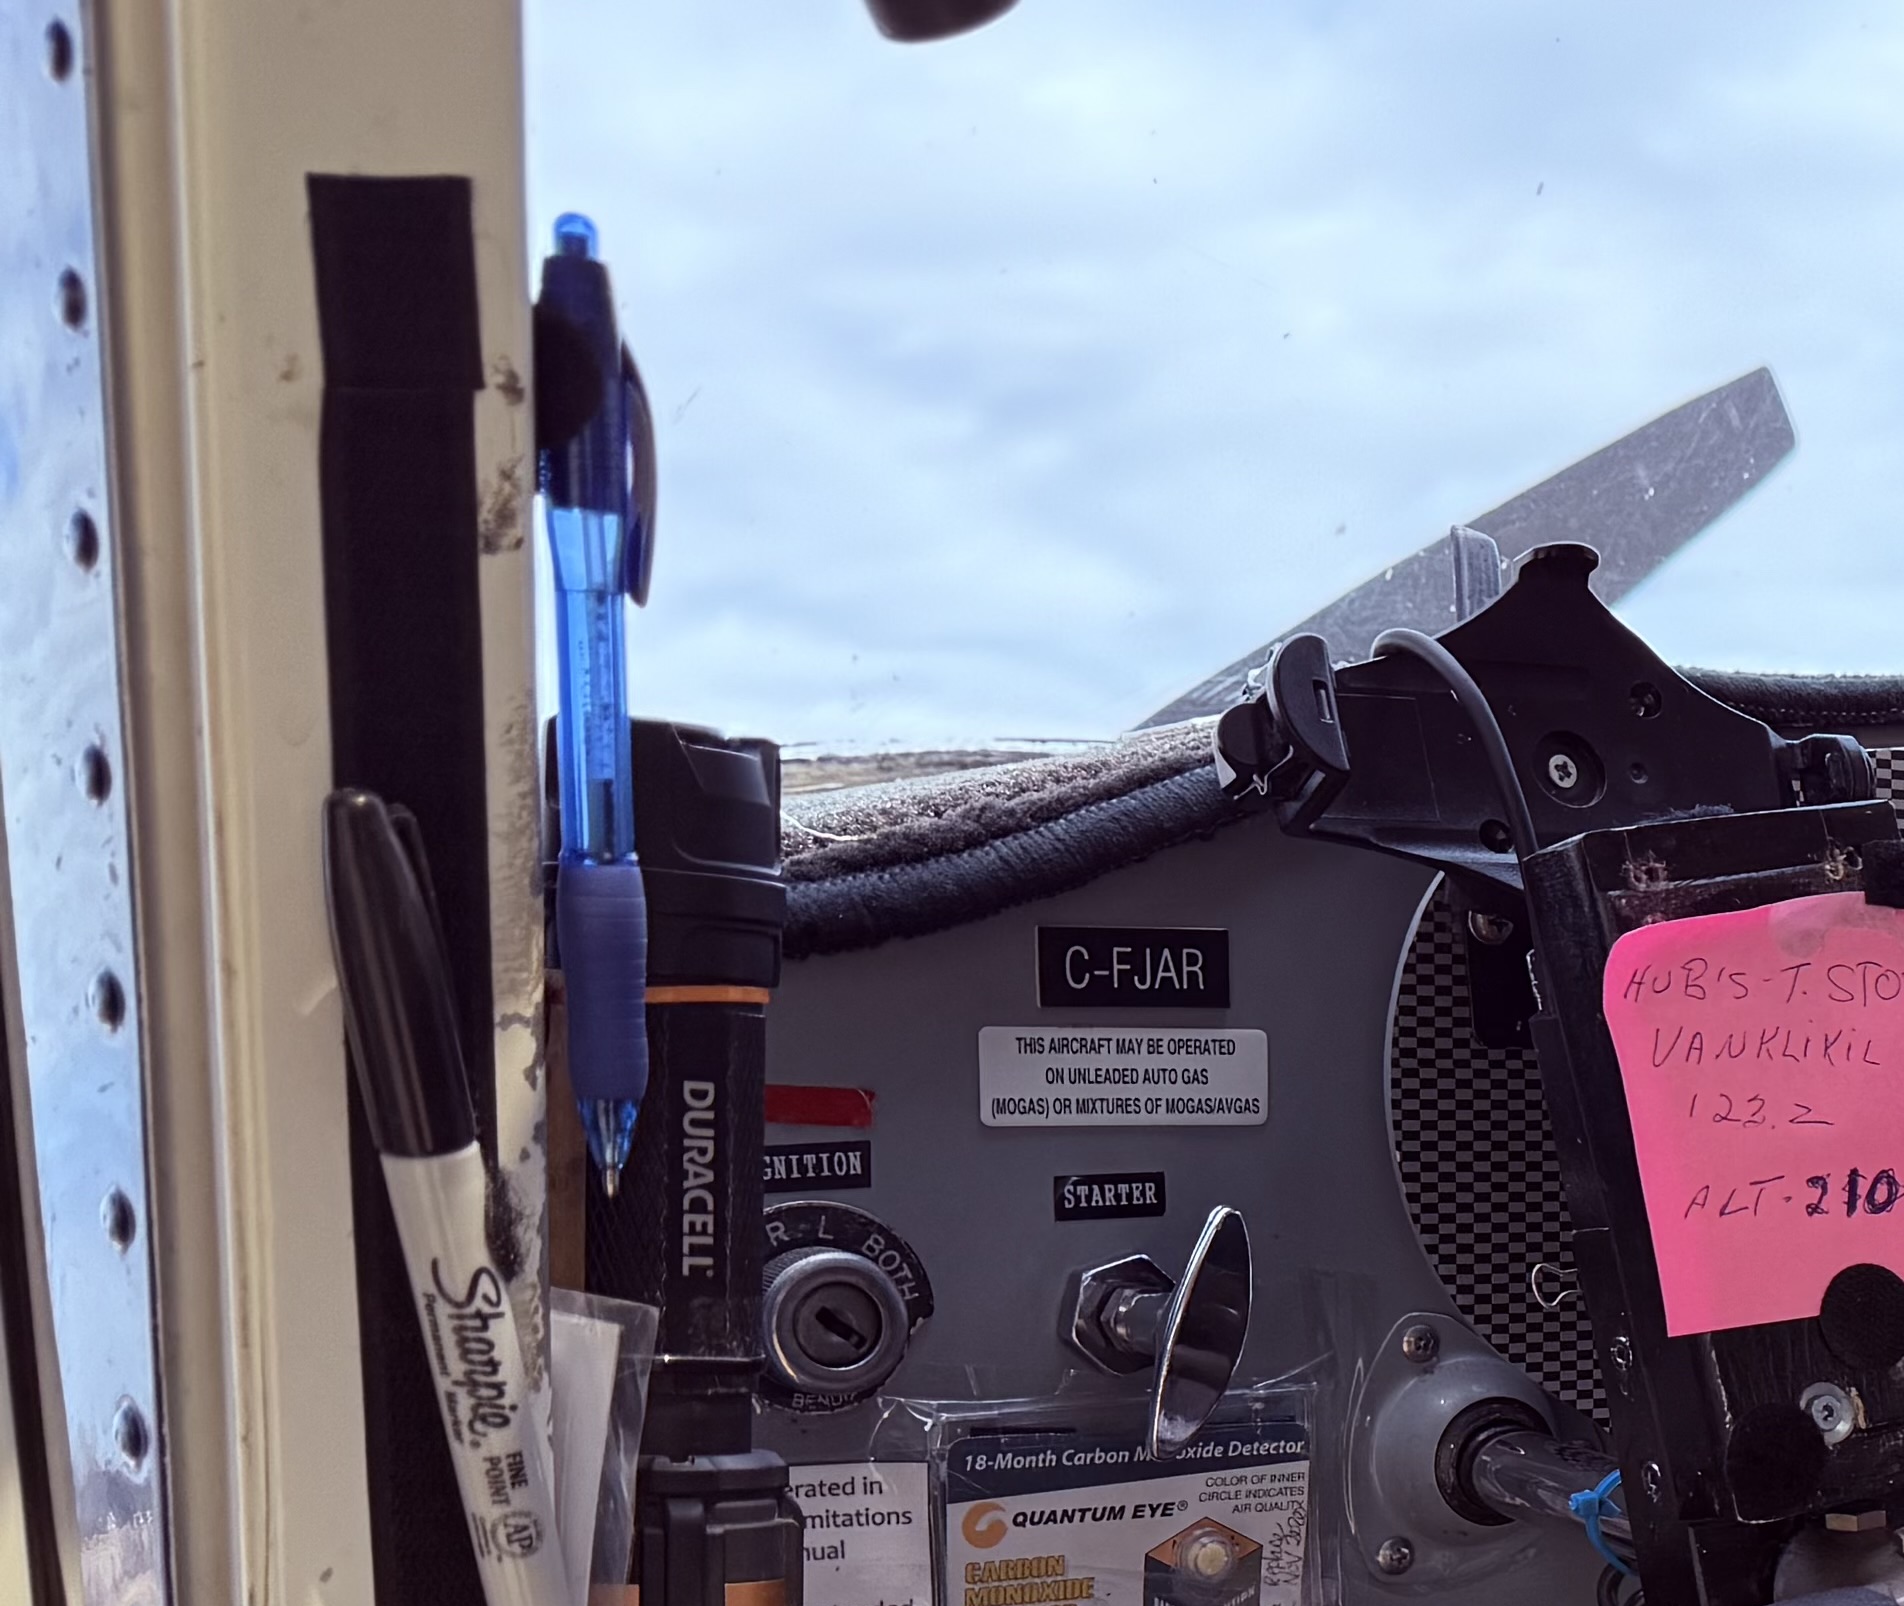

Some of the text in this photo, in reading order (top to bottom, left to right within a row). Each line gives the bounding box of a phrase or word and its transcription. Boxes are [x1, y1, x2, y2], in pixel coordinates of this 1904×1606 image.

[1065, 945, 1205, 990] C-FJAR
[1016, 1037, 1236, 1056] THIS AIRCRAFT MAY BE OPERATED
[1045, 1067, 1209, 1085] ON UNLEADED AUTO GAS
[991, 1097, 1260, 1119] (MOGAS) OR MIXTURES OF MOGAS/AVGAS
[763, 1151, 863, 1180] GNITION
[682, 1080, 715, 1277] DURACELL
[1063, 1182, 1158, 1208] STARTER
[861, 1233, 919, 1301] BOTH
[431, 1257, 519, 1439] Sharpie
[964, 1439, 1305, 1472] 18-Month Carbon Moxide Detector
[483, 1456, 511, 1507] POINT
[506, 1451, 529, 1490] FINE
[1205, 1471, 1305, 1487] COLOR OF INNER
[784, 1476, 883, 1498] erated in
[1199, 1486, 1305, 1503] CIRCLE INDICATES
[804, 1508, 913, 1529] mitations
[1012, 1504, 1125, 1528] QUANTUM
[1232, 1499, 1305, 1514] AIR QUALITY
[804, 1539, 845, 1561] nual
[964, 1555, 1065, 1584] CARBON
